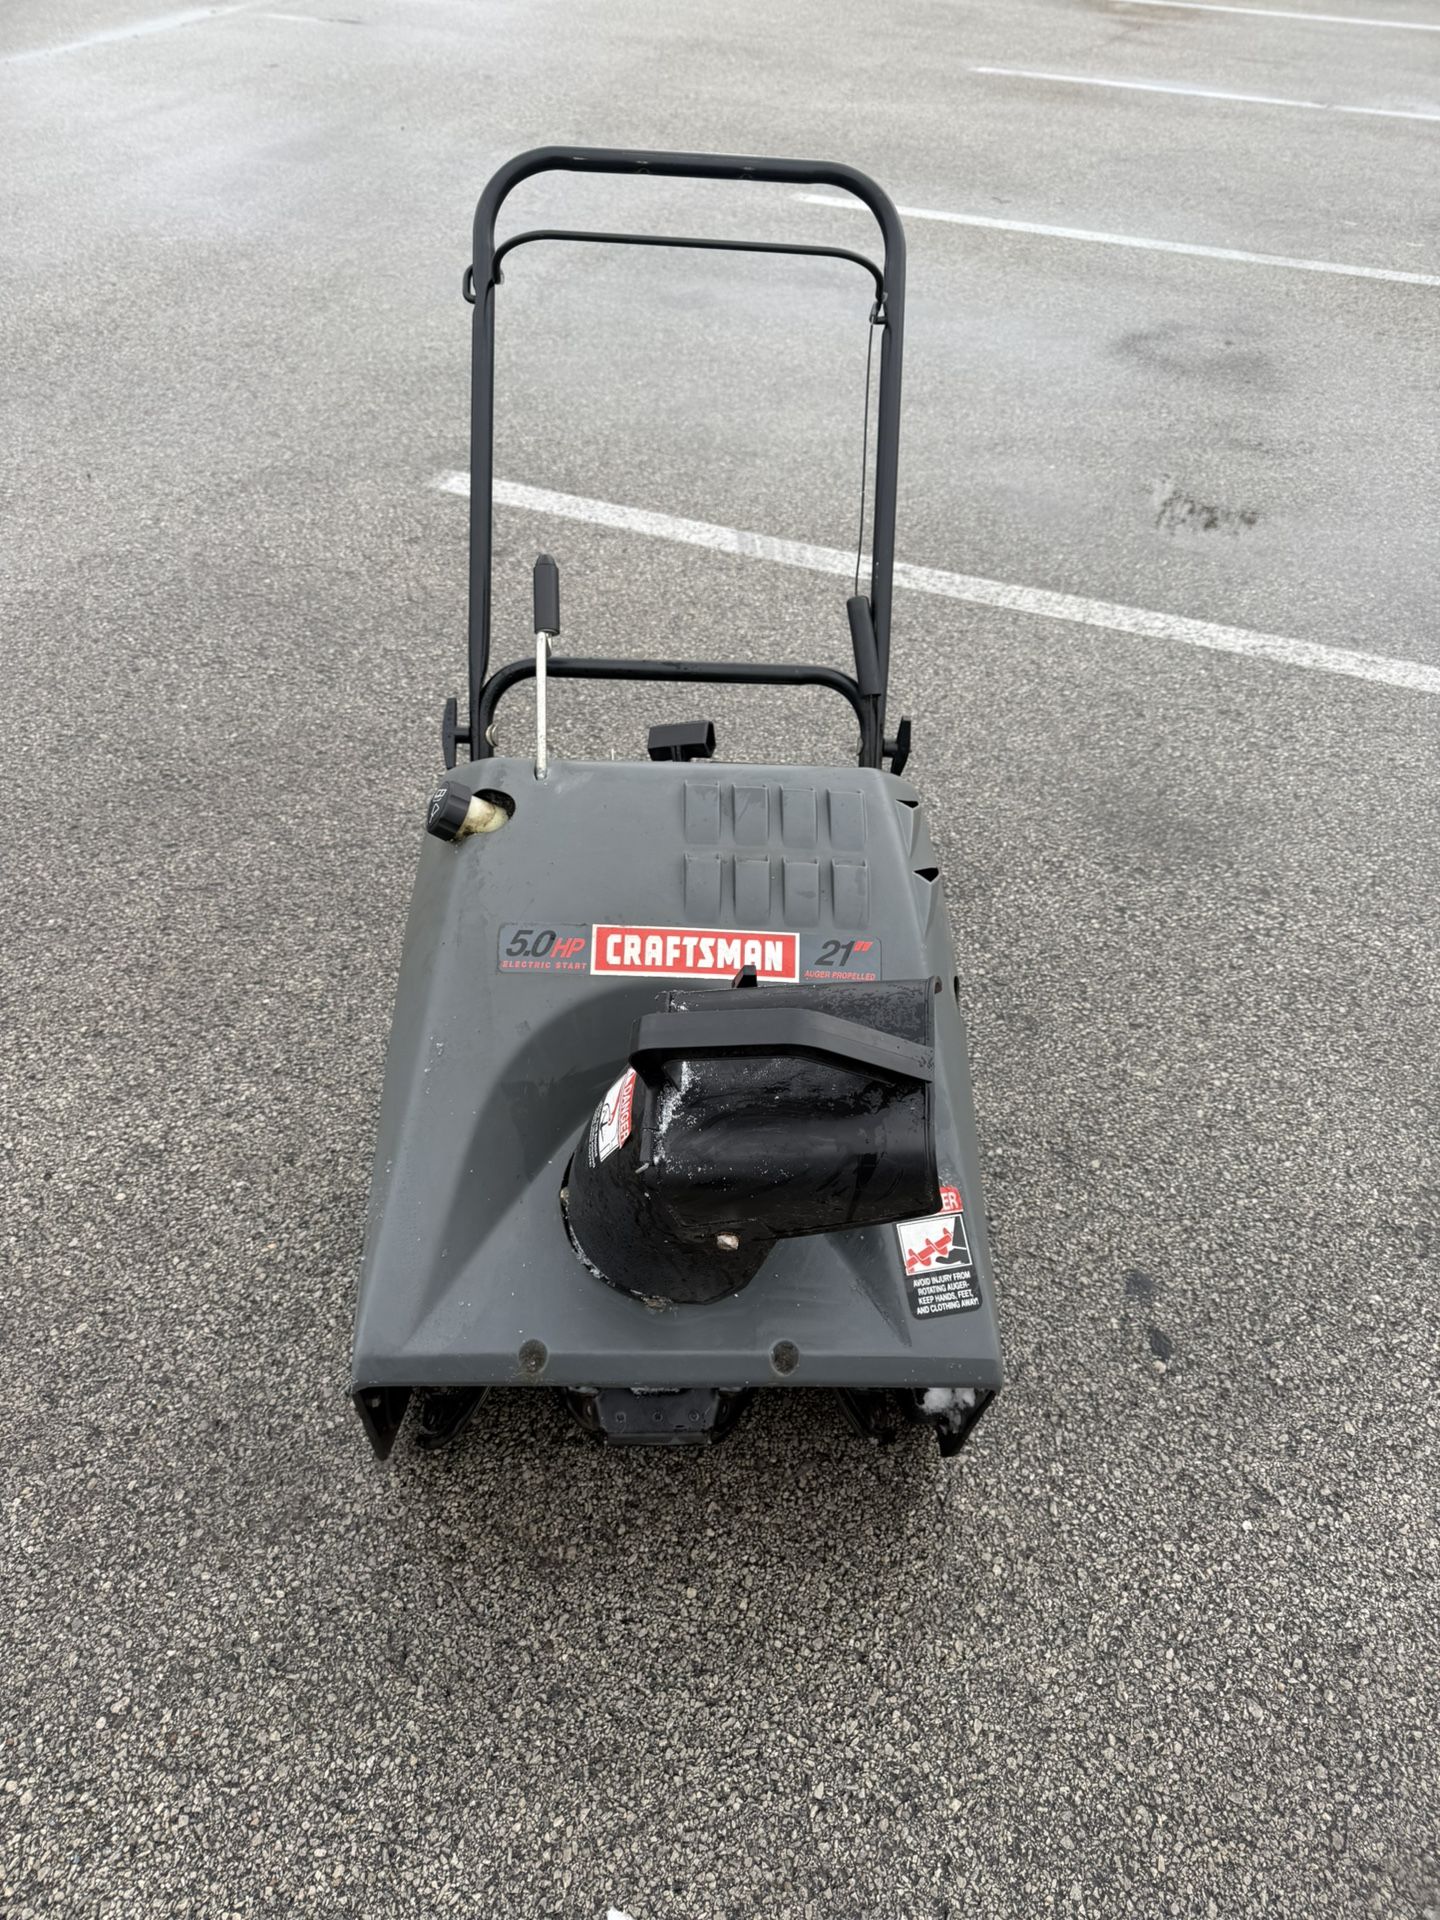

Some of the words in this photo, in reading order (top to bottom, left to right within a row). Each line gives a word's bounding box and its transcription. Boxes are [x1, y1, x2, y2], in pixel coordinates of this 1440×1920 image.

[606, 933, 783, 972] CRAFTSMAN
[502, 960, 551, 969] ELECTRIC
[555, 961, 588, 970] START
[804, 969, 832, 979] AUGER
[832, 971, 876, 981] PROPELLED
[620, 1084, 632, 1141] DANGER
[913, 1278, 930, 1287] AVOID
[931, 1274, 952, 1284] INJURY
[953, 1271, 971, 1280] FROM
[918, 1284, 946, 1295] ROTATING
[947, 1281, 970, 1291] AUGER-
[918, 1296, 934, 1305] KEEP
[957, 1289, 974, 1298] FEET,
[917, 1305, 930, 1315] AND
[930, 1301, 960, 1312] CLOTHING
